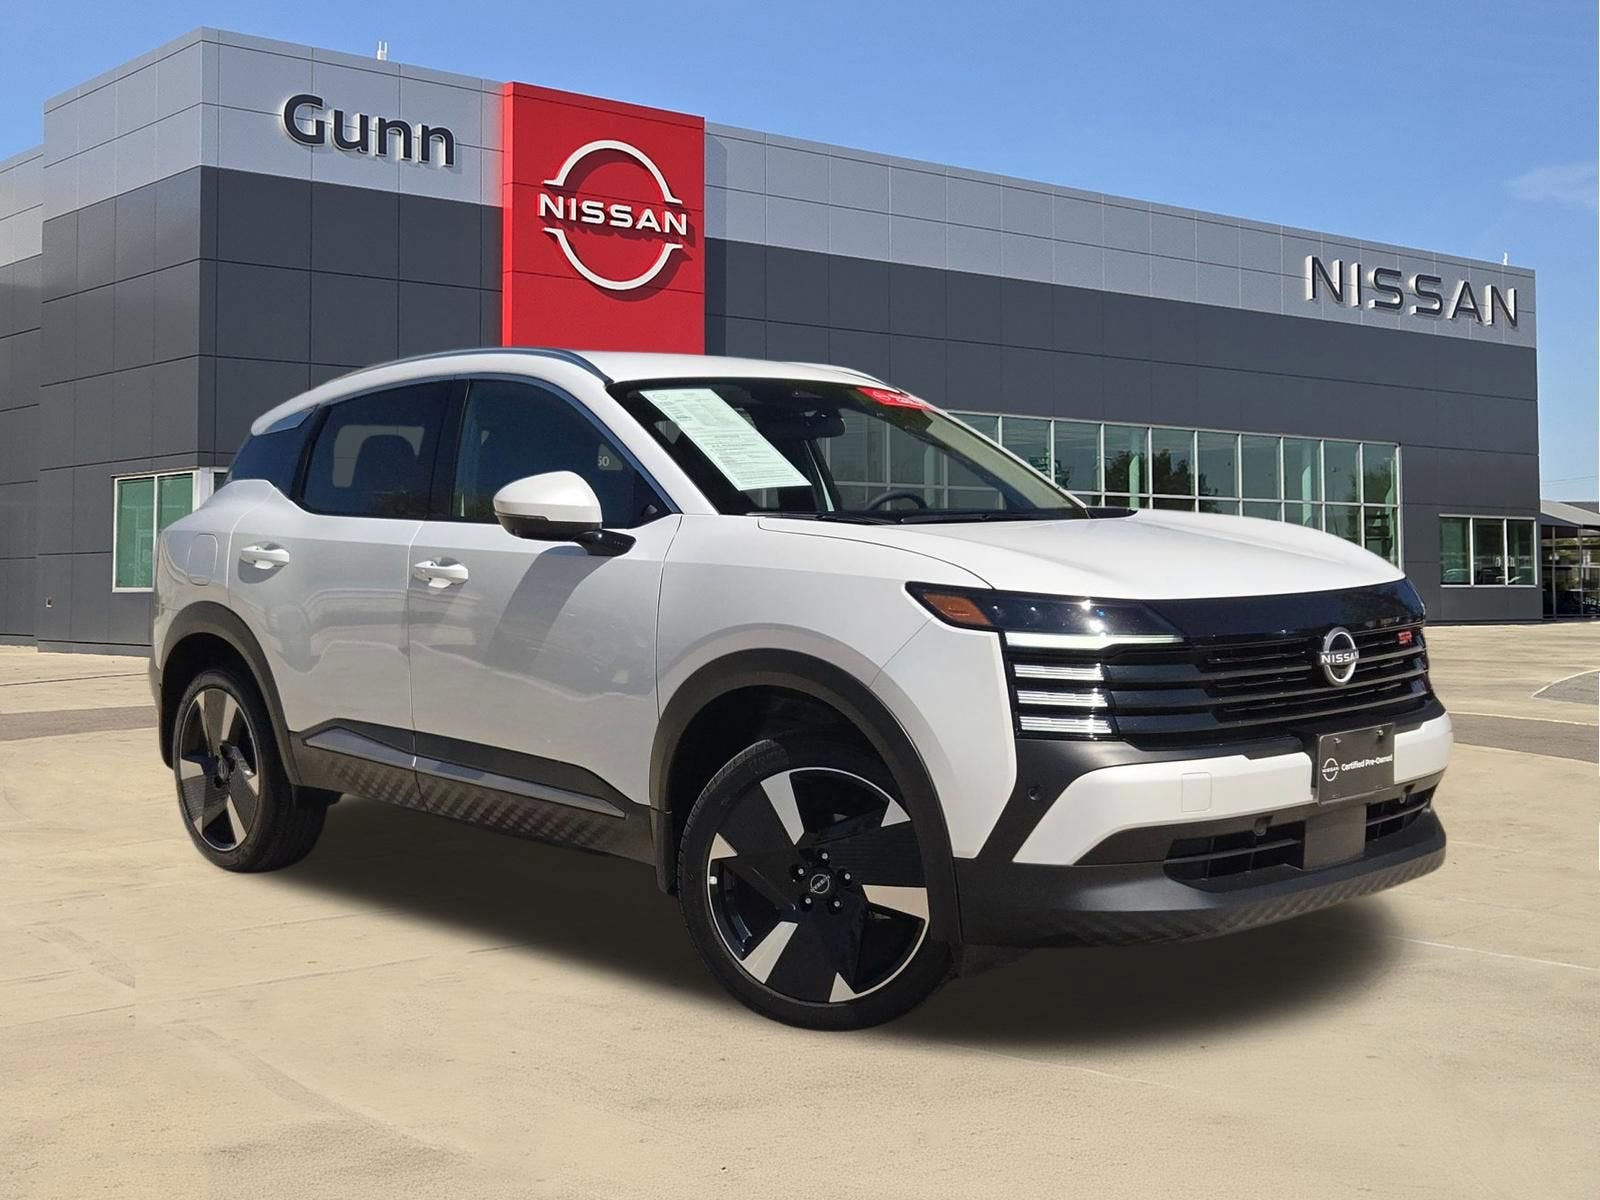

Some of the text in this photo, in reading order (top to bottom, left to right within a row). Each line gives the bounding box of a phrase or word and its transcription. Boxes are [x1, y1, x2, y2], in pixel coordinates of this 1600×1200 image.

[282, 94, 455, 167] Gunn
[538, 193, 687, 235] NISSAN
[1305, 255, 1518, 327] NISSAN
[1321, 651, 1359, 664] NISSAN
[1341, 754, 1393, 771] Certified Pre-Owned
